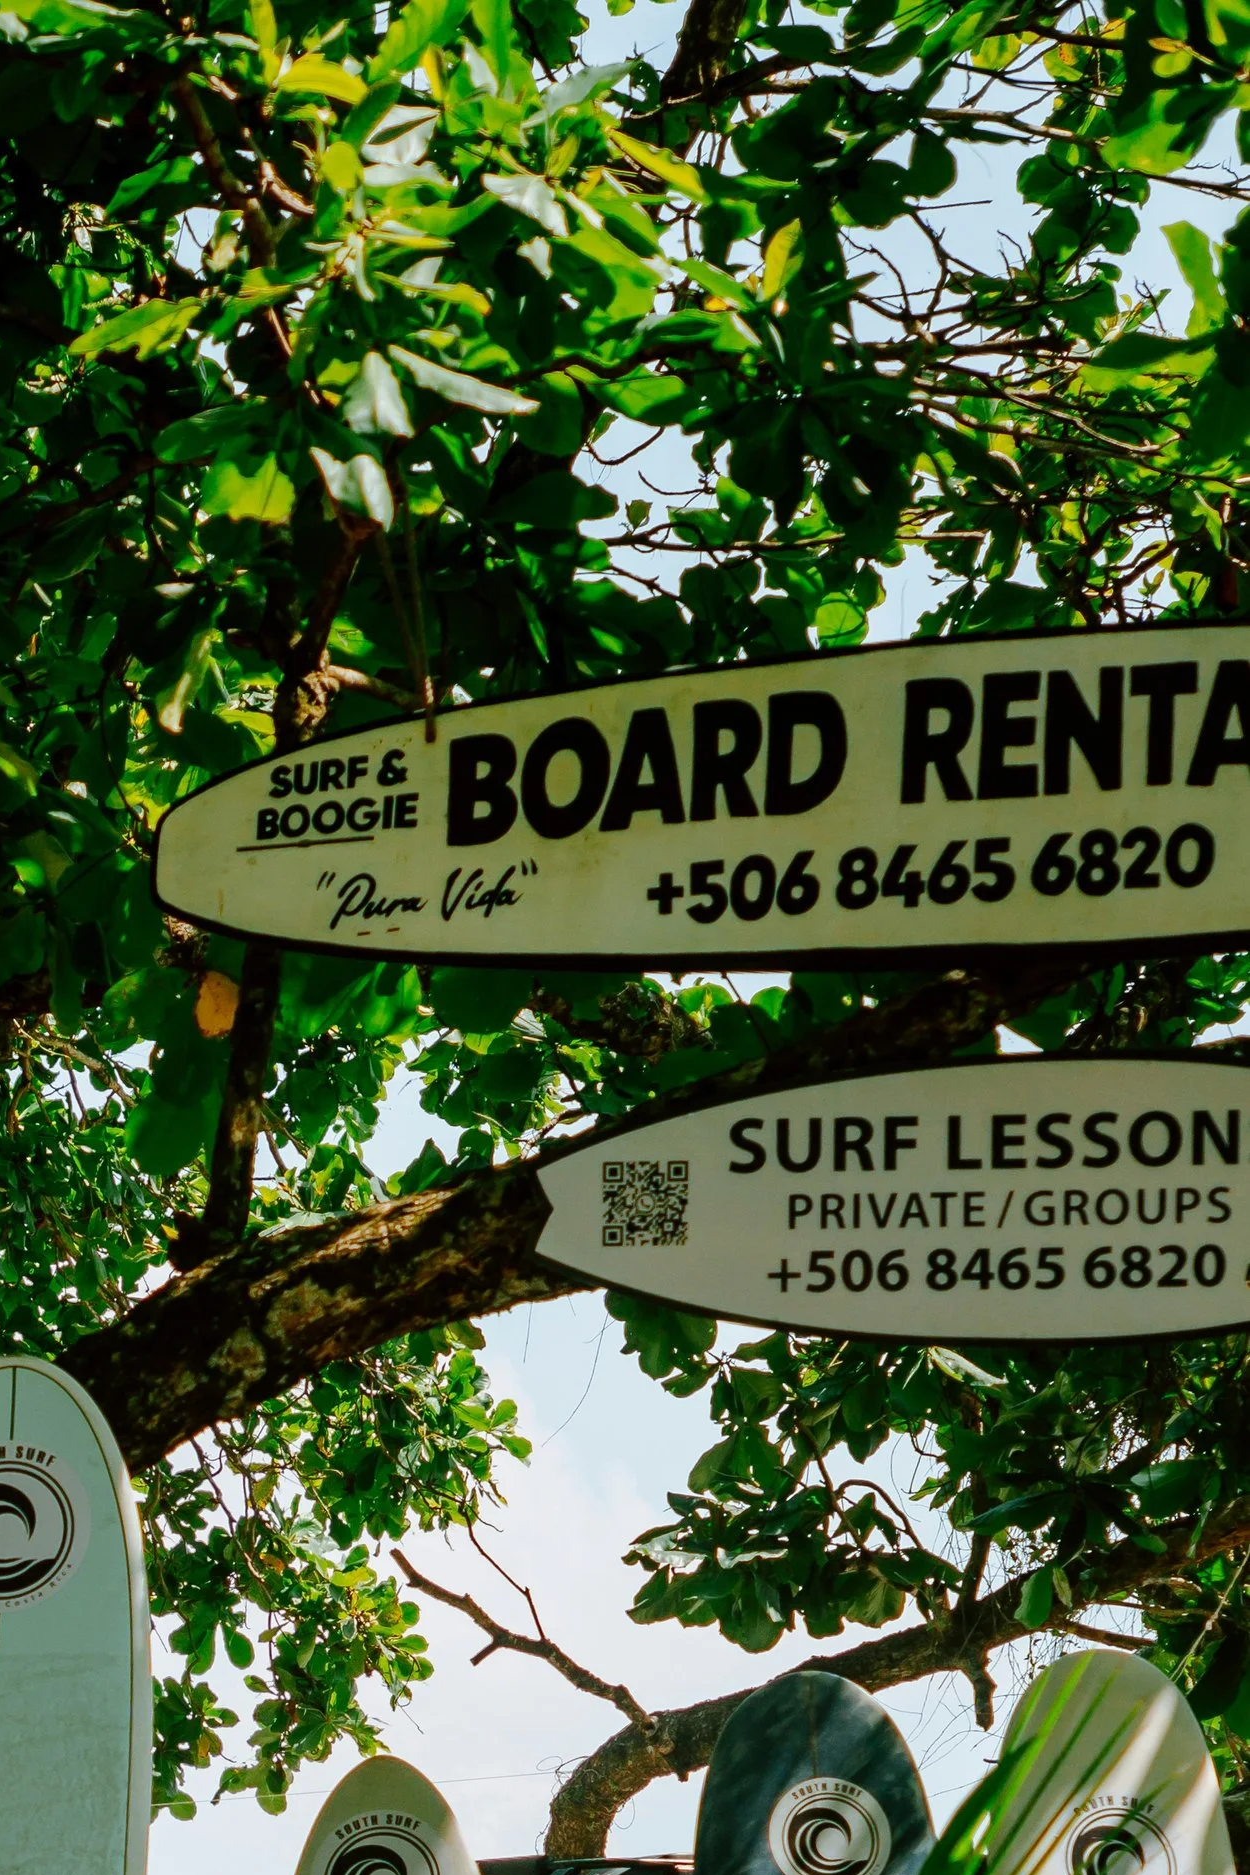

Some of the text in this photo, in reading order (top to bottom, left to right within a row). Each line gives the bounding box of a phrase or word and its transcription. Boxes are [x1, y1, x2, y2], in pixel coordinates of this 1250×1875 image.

[268, 748, 409, 799] SURF &
[445, 658, 1250, 847] BOARD RENTA
[255, 792, 420, 841] BOOGIE
[646, 822, 1216, 925] +506 8465 6820
[728, 1109, 1241, 1175] SURF LESSON
[767, 1243, 1227, 1293] +506 8465 6820
[15, 1445, 58, 1467] SURF
[334, 1813, 422, 1840] SOUTH SURF
